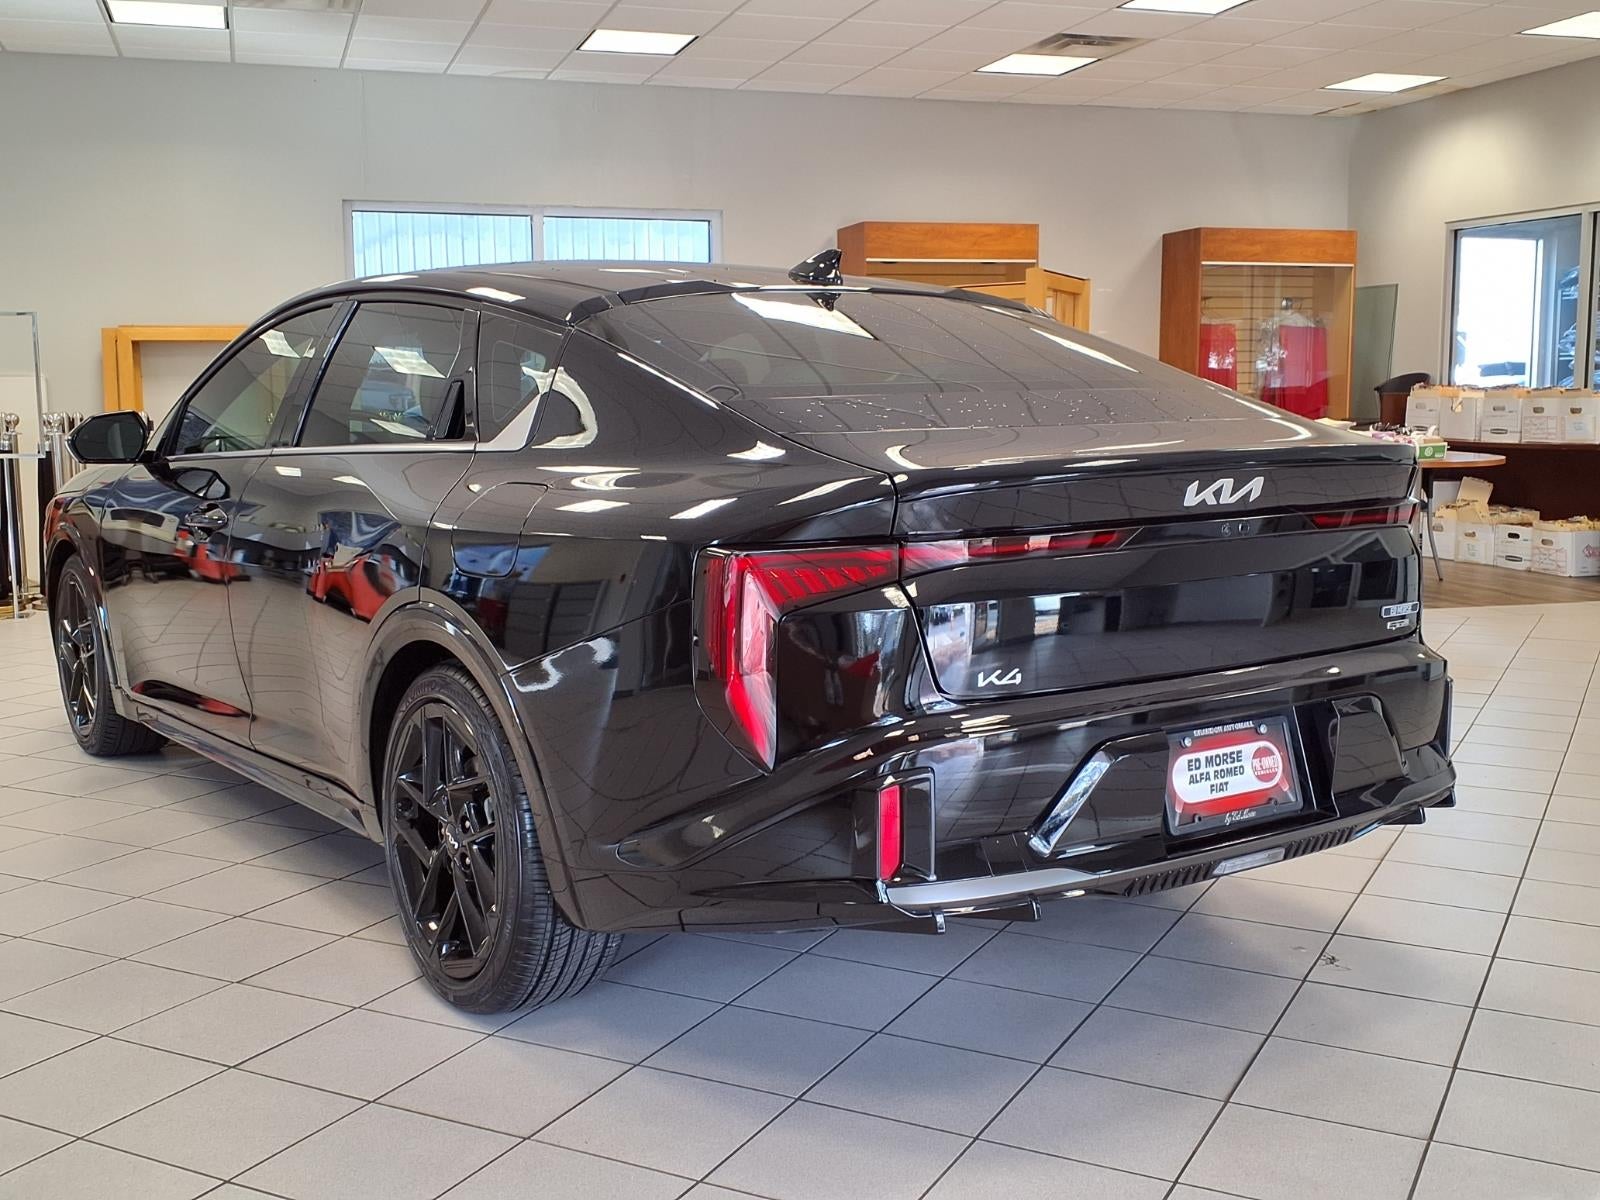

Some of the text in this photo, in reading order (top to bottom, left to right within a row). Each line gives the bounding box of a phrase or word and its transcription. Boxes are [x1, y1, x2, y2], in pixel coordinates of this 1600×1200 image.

[1183, 476, 1265, 507] KIA
[977, 668, 1022, 688] K4
[1187, 750, 1243, 772] ED MORSE
[1188, 765, 1245, 785] ALFA ROMEO
[1209, 782, 1229, 795] FIAT
